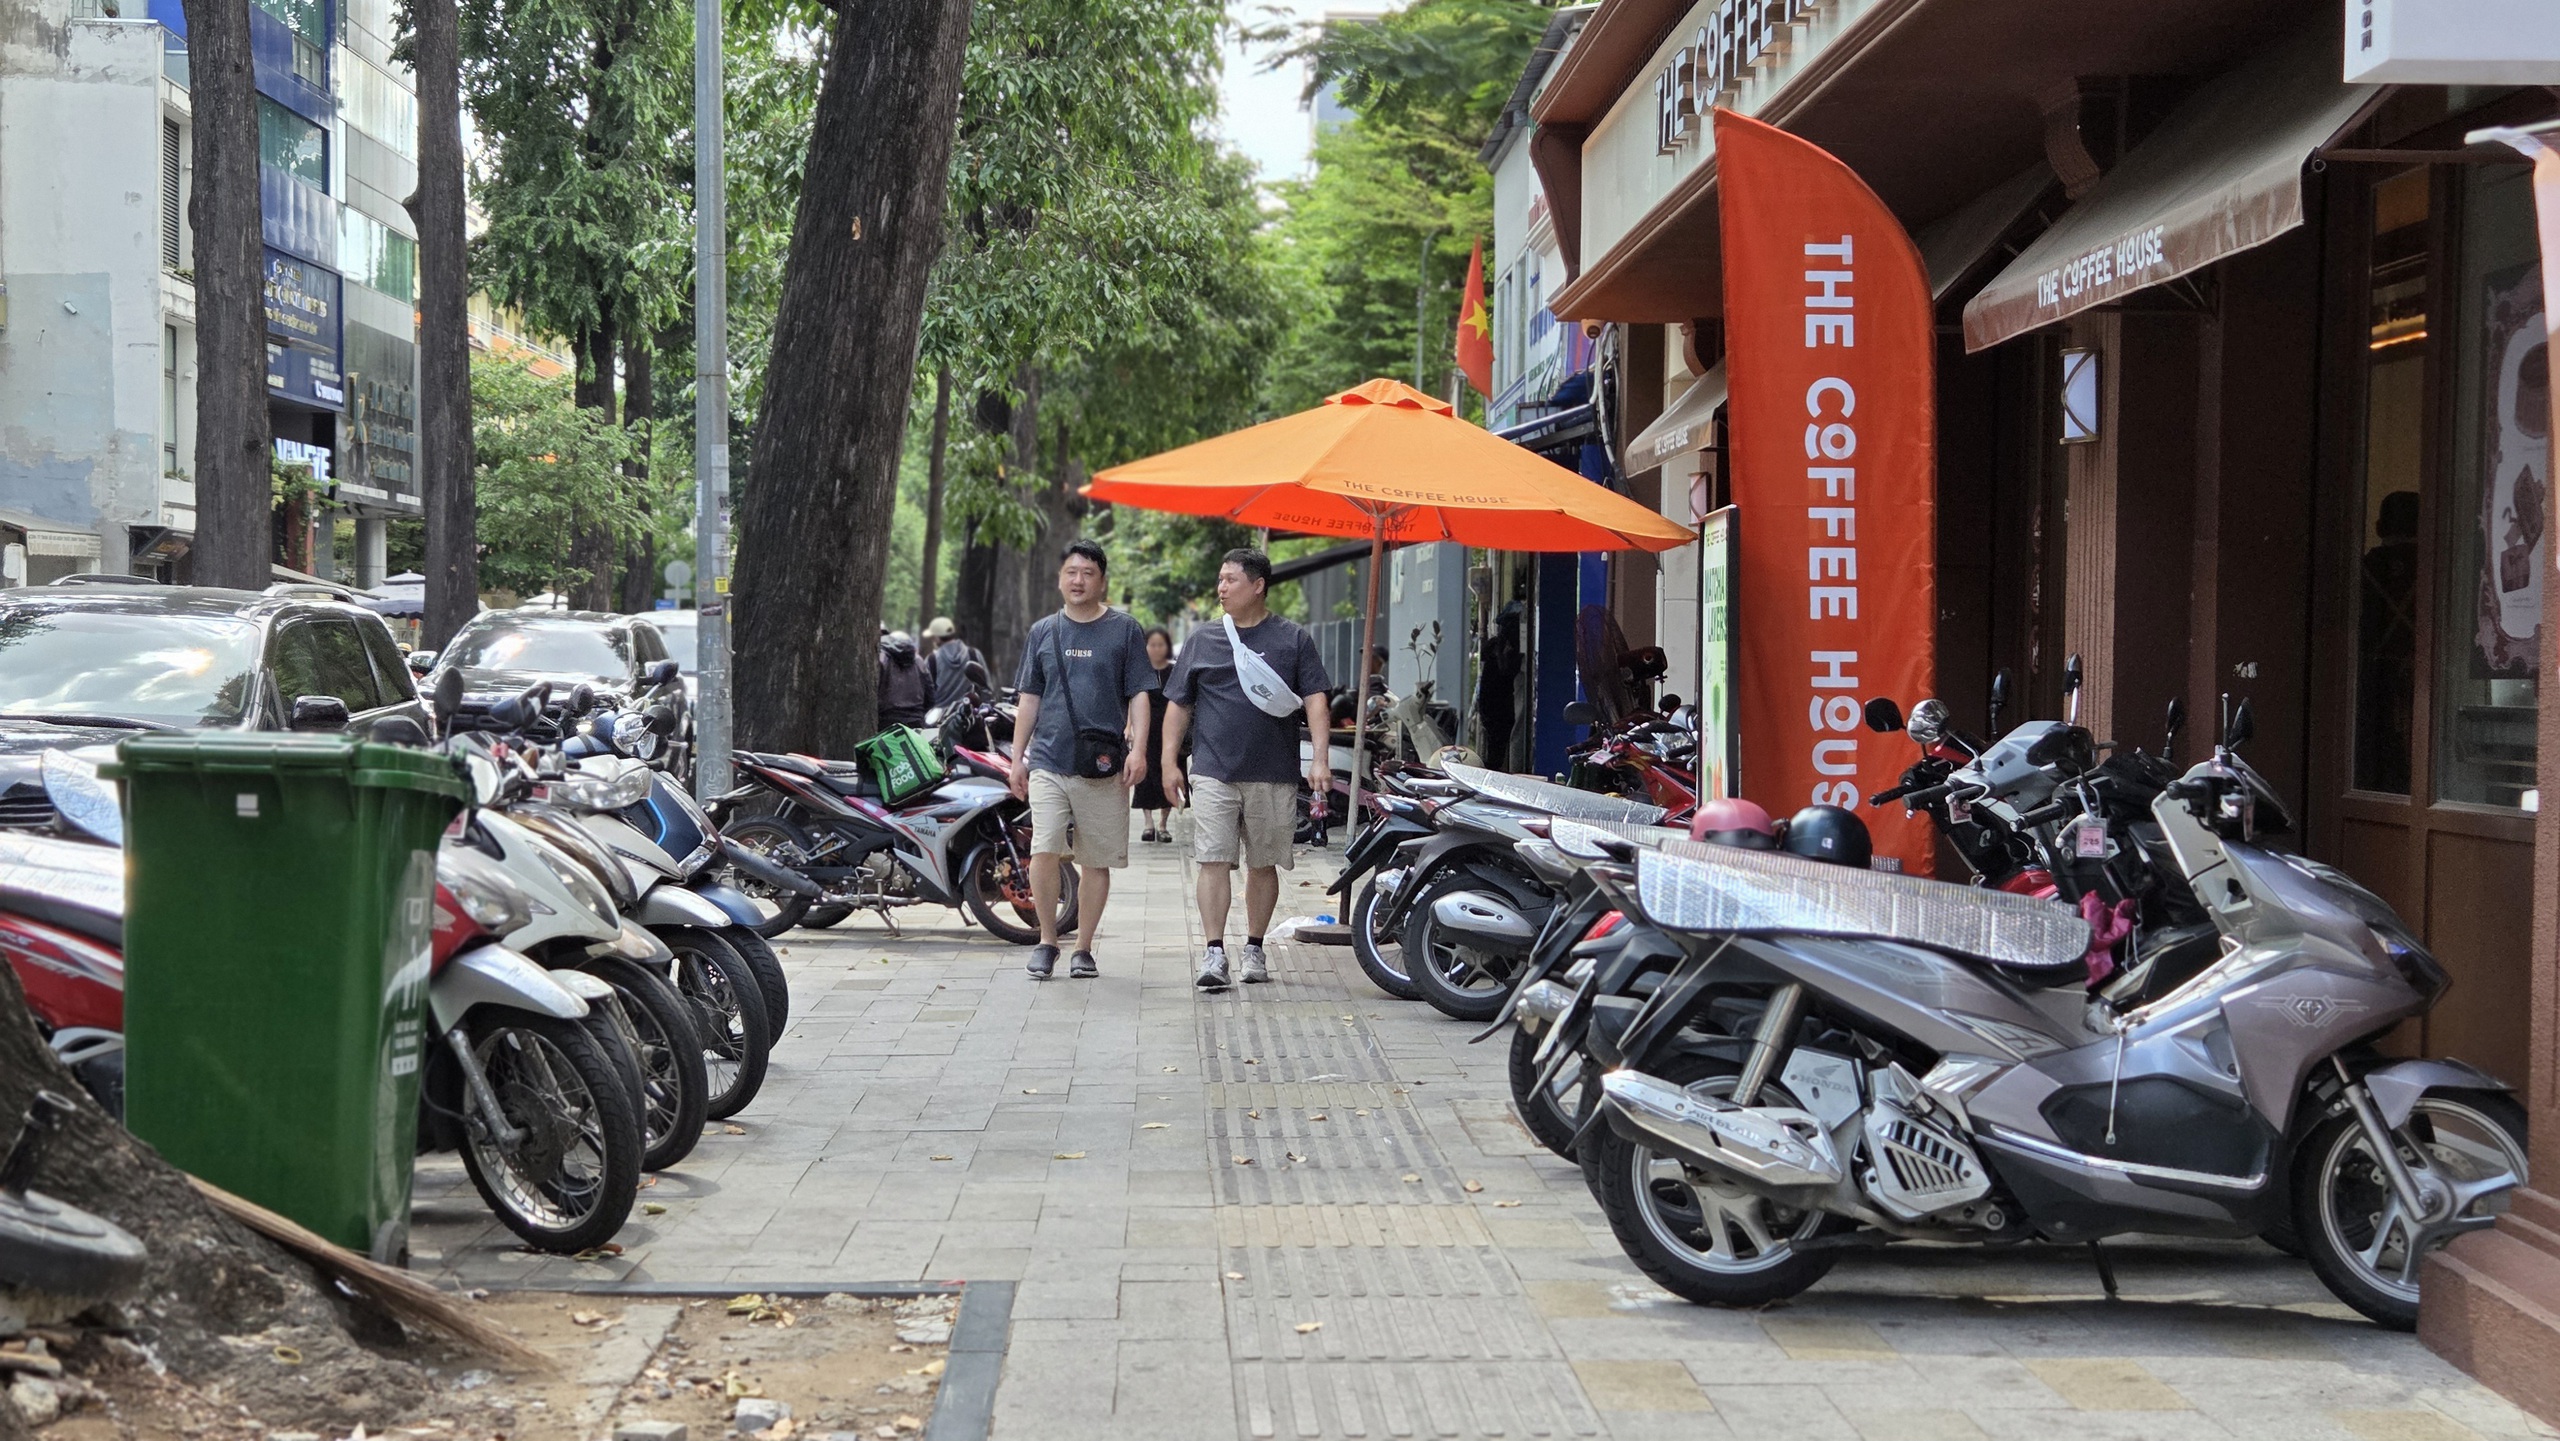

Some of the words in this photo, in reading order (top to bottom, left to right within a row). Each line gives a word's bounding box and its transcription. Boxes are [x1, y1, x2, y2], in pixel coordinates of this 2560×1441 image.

[1654, 48, 1687, 157] THE
[1692, 0, 1774, 116] COFFEE
[1804, 234, 1854, 348] THE
[2037, 268, 2060, 309] THE
[2062, 246, 2113, 298] COFFEE
[2116, 224, 2164, 278] HOUSE
[1343, 480, 1374, 492] THE
[1381, 487, 1447, 502] COFFEE
[1453, 495, 1510, 504] HOUSE
[1804, 376, 1858, 620] COFFEE
[1808, 650, 1861, 812] HOUS
[891, 767, 915, 788] Food
[914, 826, 936, 838] YAMAHA
[1797, 1074, 1853, 1094] HONDA
